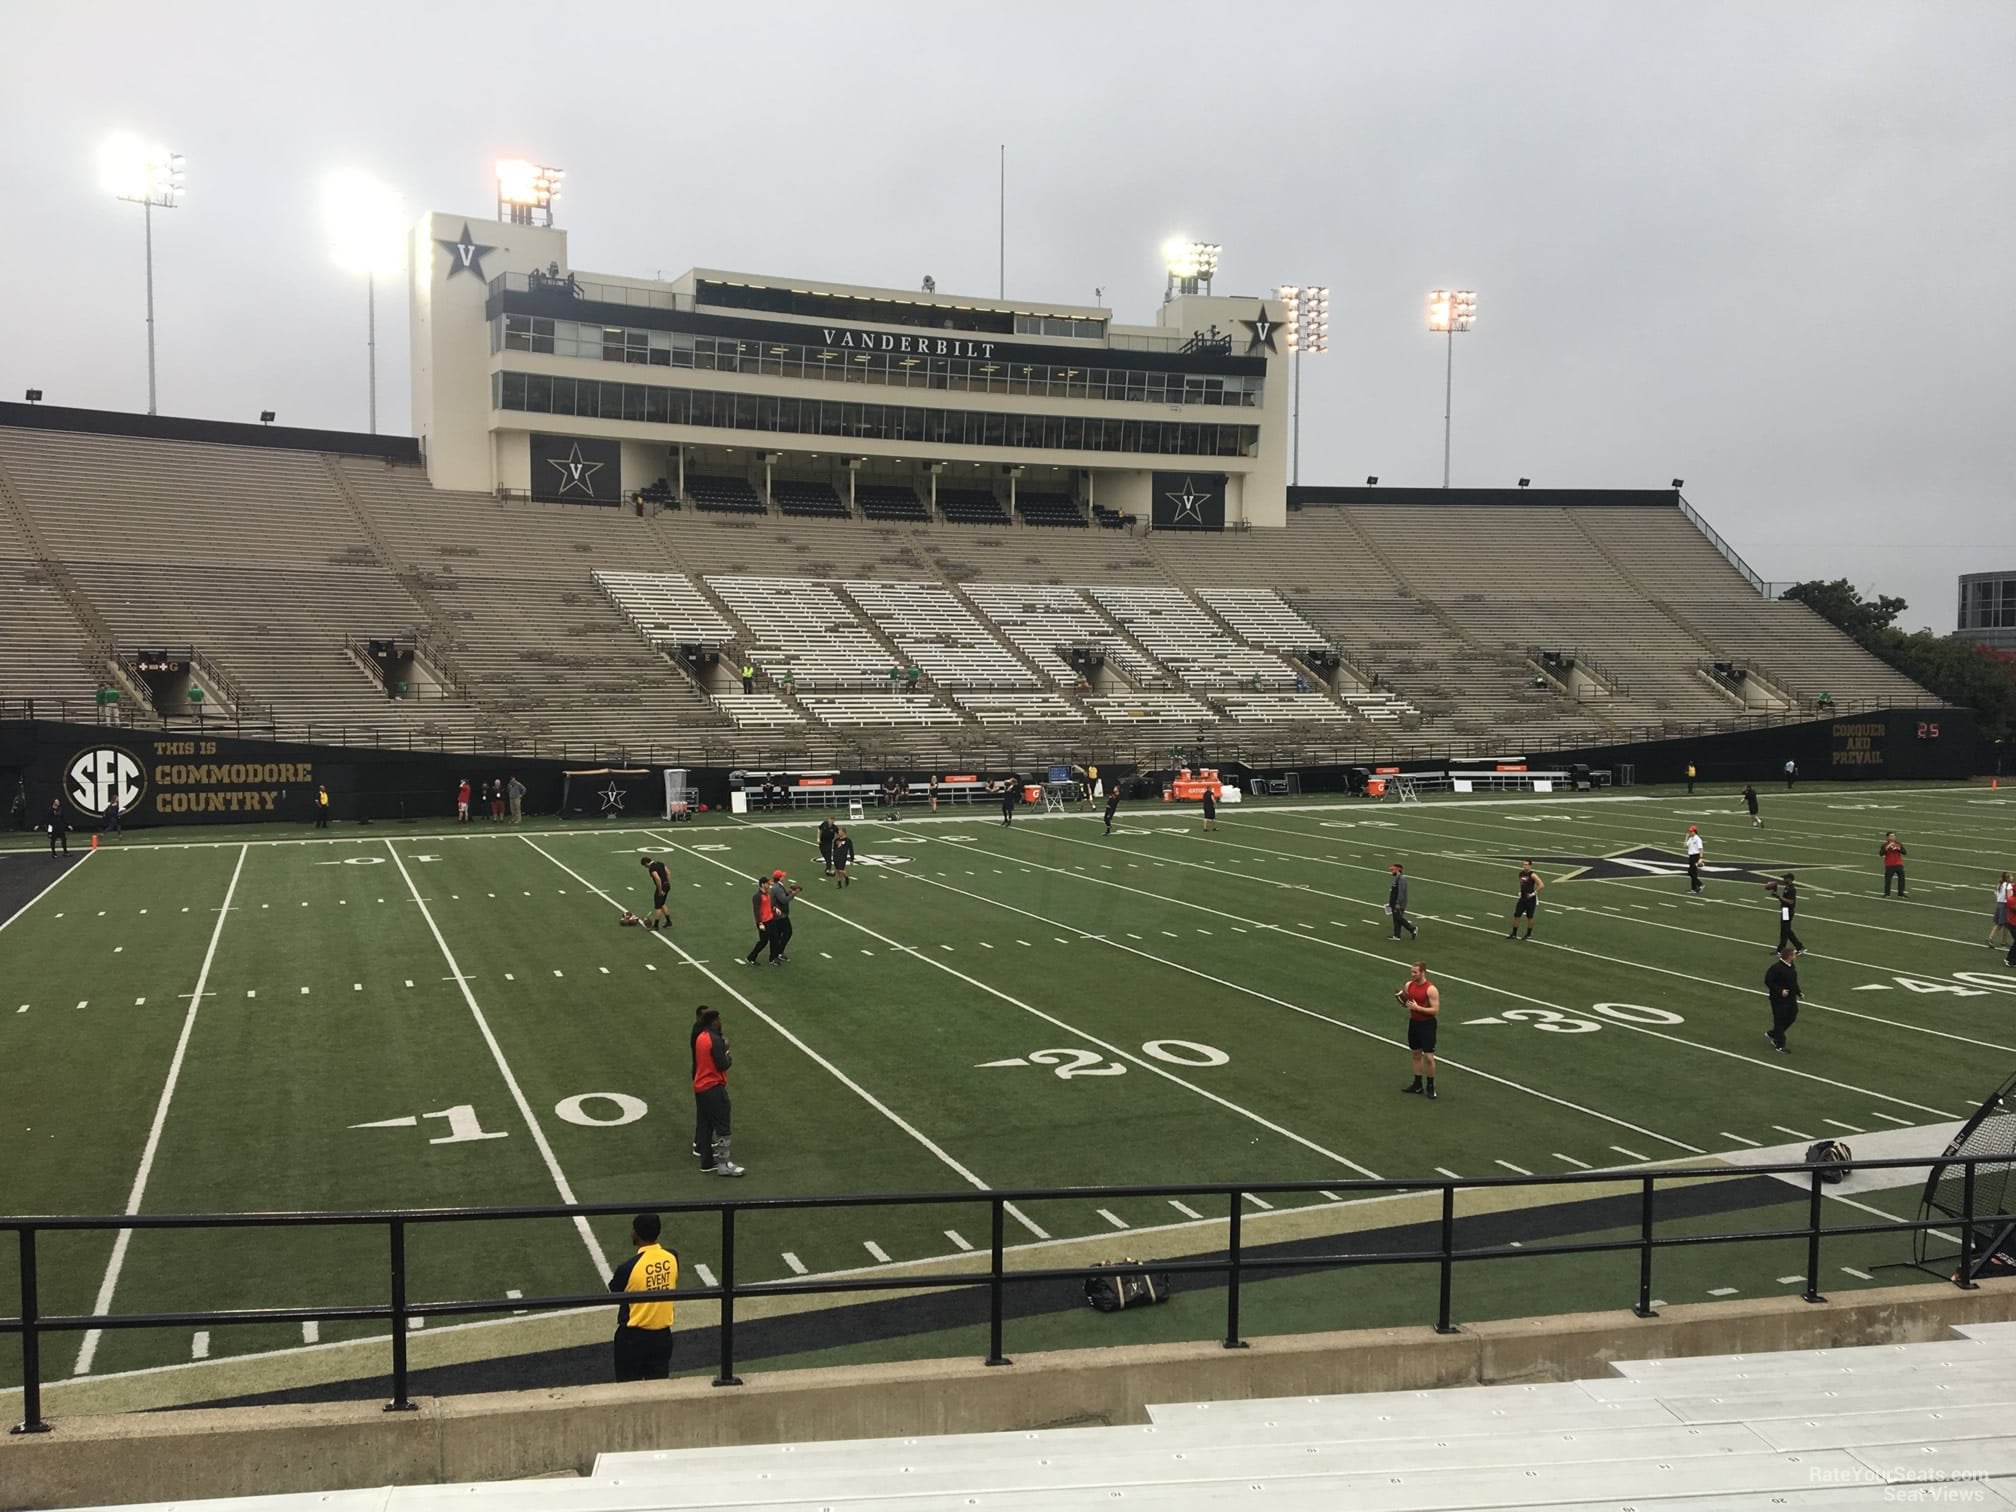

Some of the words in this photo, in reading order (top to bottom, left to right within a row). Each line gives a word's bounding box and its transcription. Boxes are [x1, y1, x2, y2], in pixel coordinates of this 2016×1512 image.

[457, 244, 476, 267] V
[1256, 322, 1270, 341] V
[823, 329, 995, 358] VANDERBILT
[569, 463, 583, 480] V
[1183, 495, 1194, 510] V
[1832, 724, 1885, 737] CONQUER
[1917, 723, 1940, 737] 25
[154, 742, 195, 756] THIS
[200, 741, 217, 755] IS
[1846, 737, 1871, 750] AND
[1832, 751, 1884, 765] PREVAIL
[70, 750, 140, 812] SEC
[155, 763, 312, 785] COMMODORE
[155, 791, 279, 813] COUNTRY
[1502, 1002, 1685, 1034] 30
[1028, 1039, 1230, 1079] 20
[422, 1092, 648, 1145] 10
[645, 1260, 671, 1275] CSC
[646, 1271, 671, 1288] EVENT
